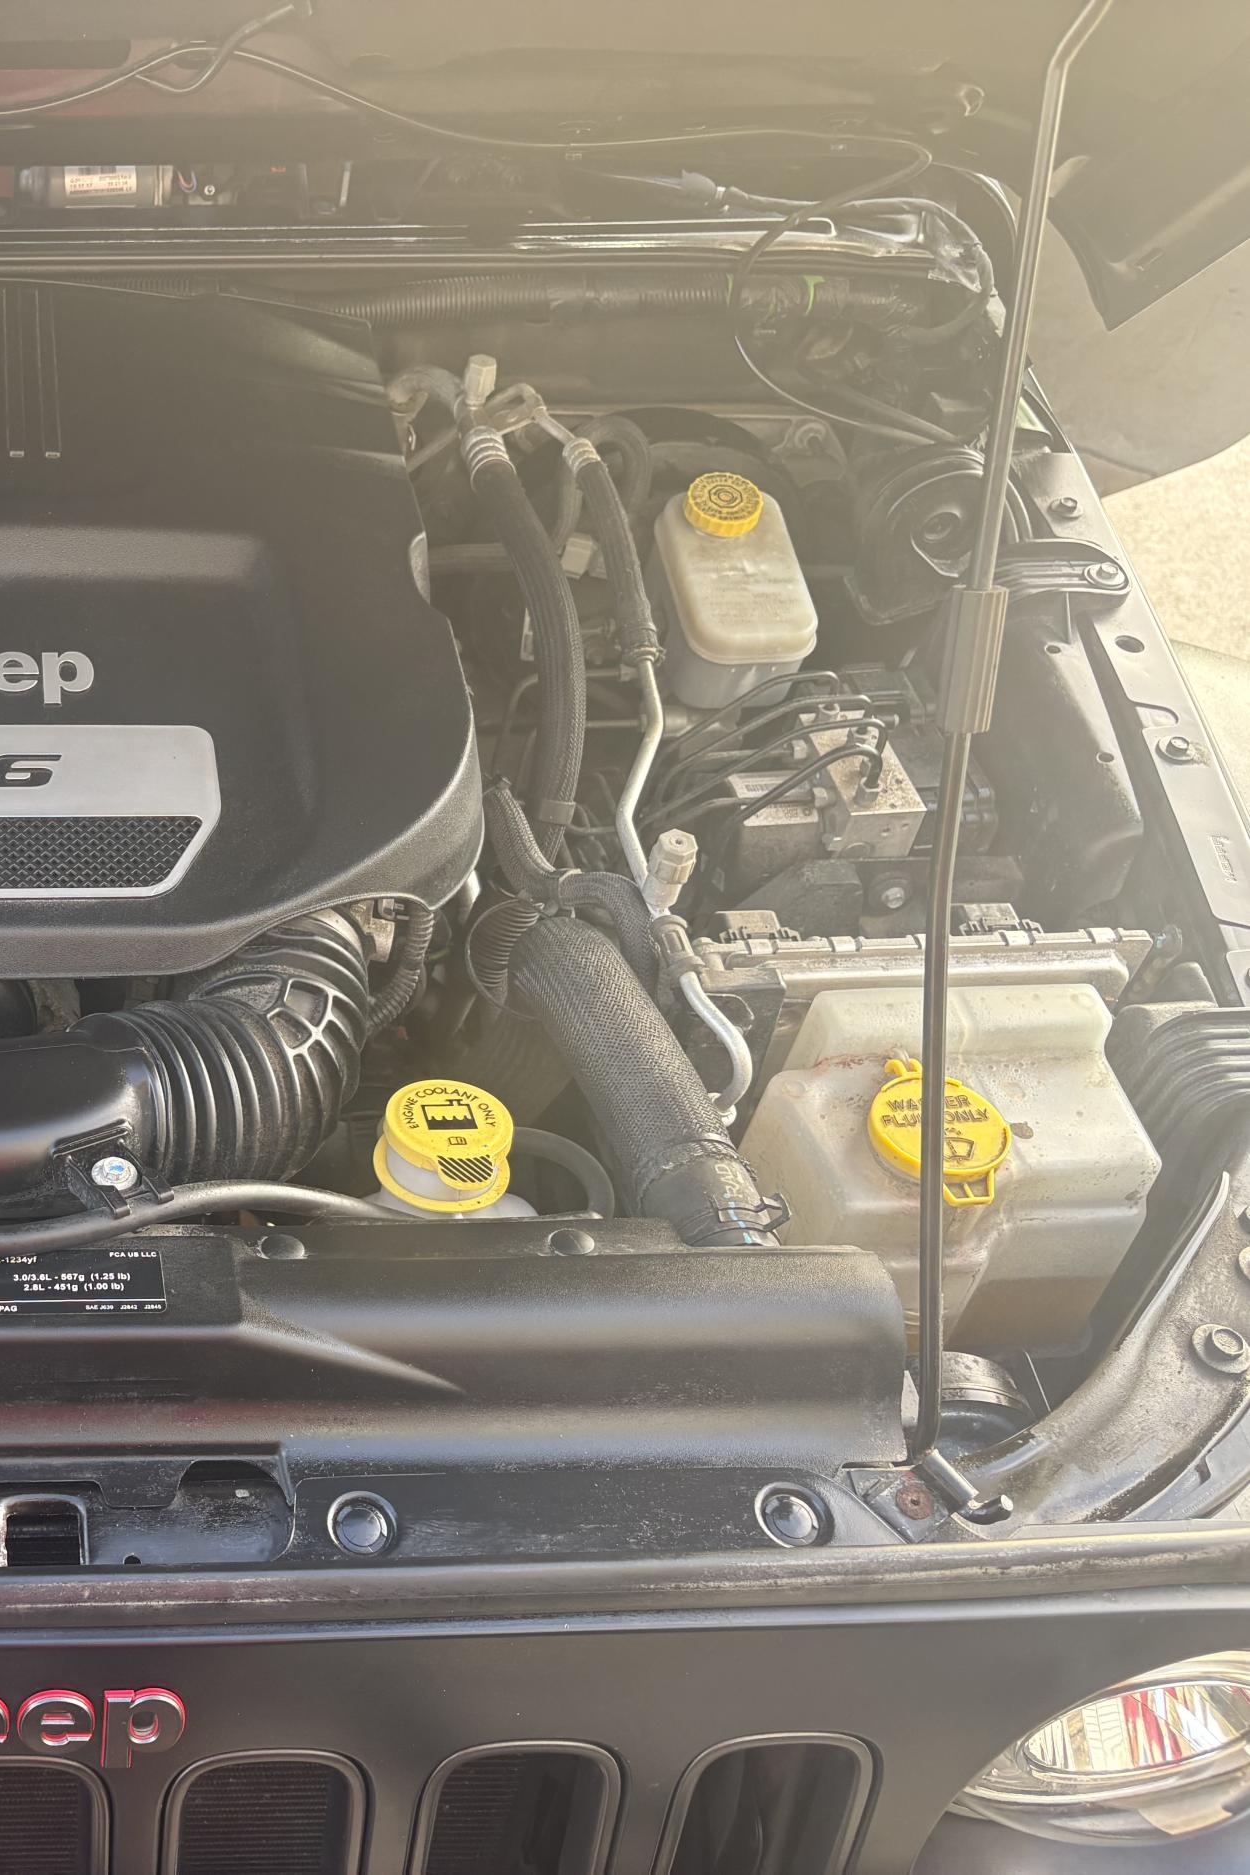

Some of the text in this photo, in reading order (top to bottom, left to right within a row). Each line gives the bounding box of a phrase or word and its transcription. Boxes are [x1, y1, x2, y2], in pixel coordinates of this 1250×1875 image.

[402, 1087, 496, 1129] ENGINE COOLANT ONLY
[886, 1095, 972, 1113] WAER
[13, 1273, 52, 1281] 3.0/3.6L
[60, 1273, 85, 1282] 567g
[90, 1272, 115, 1281] (1.25
[117, 1272, 131, 1281] lb)
[53, 1283, 79, 1292] 451g
[83, 1282, 108, 1291] (1.00
[111, 1282, 125, 1291] lb)
